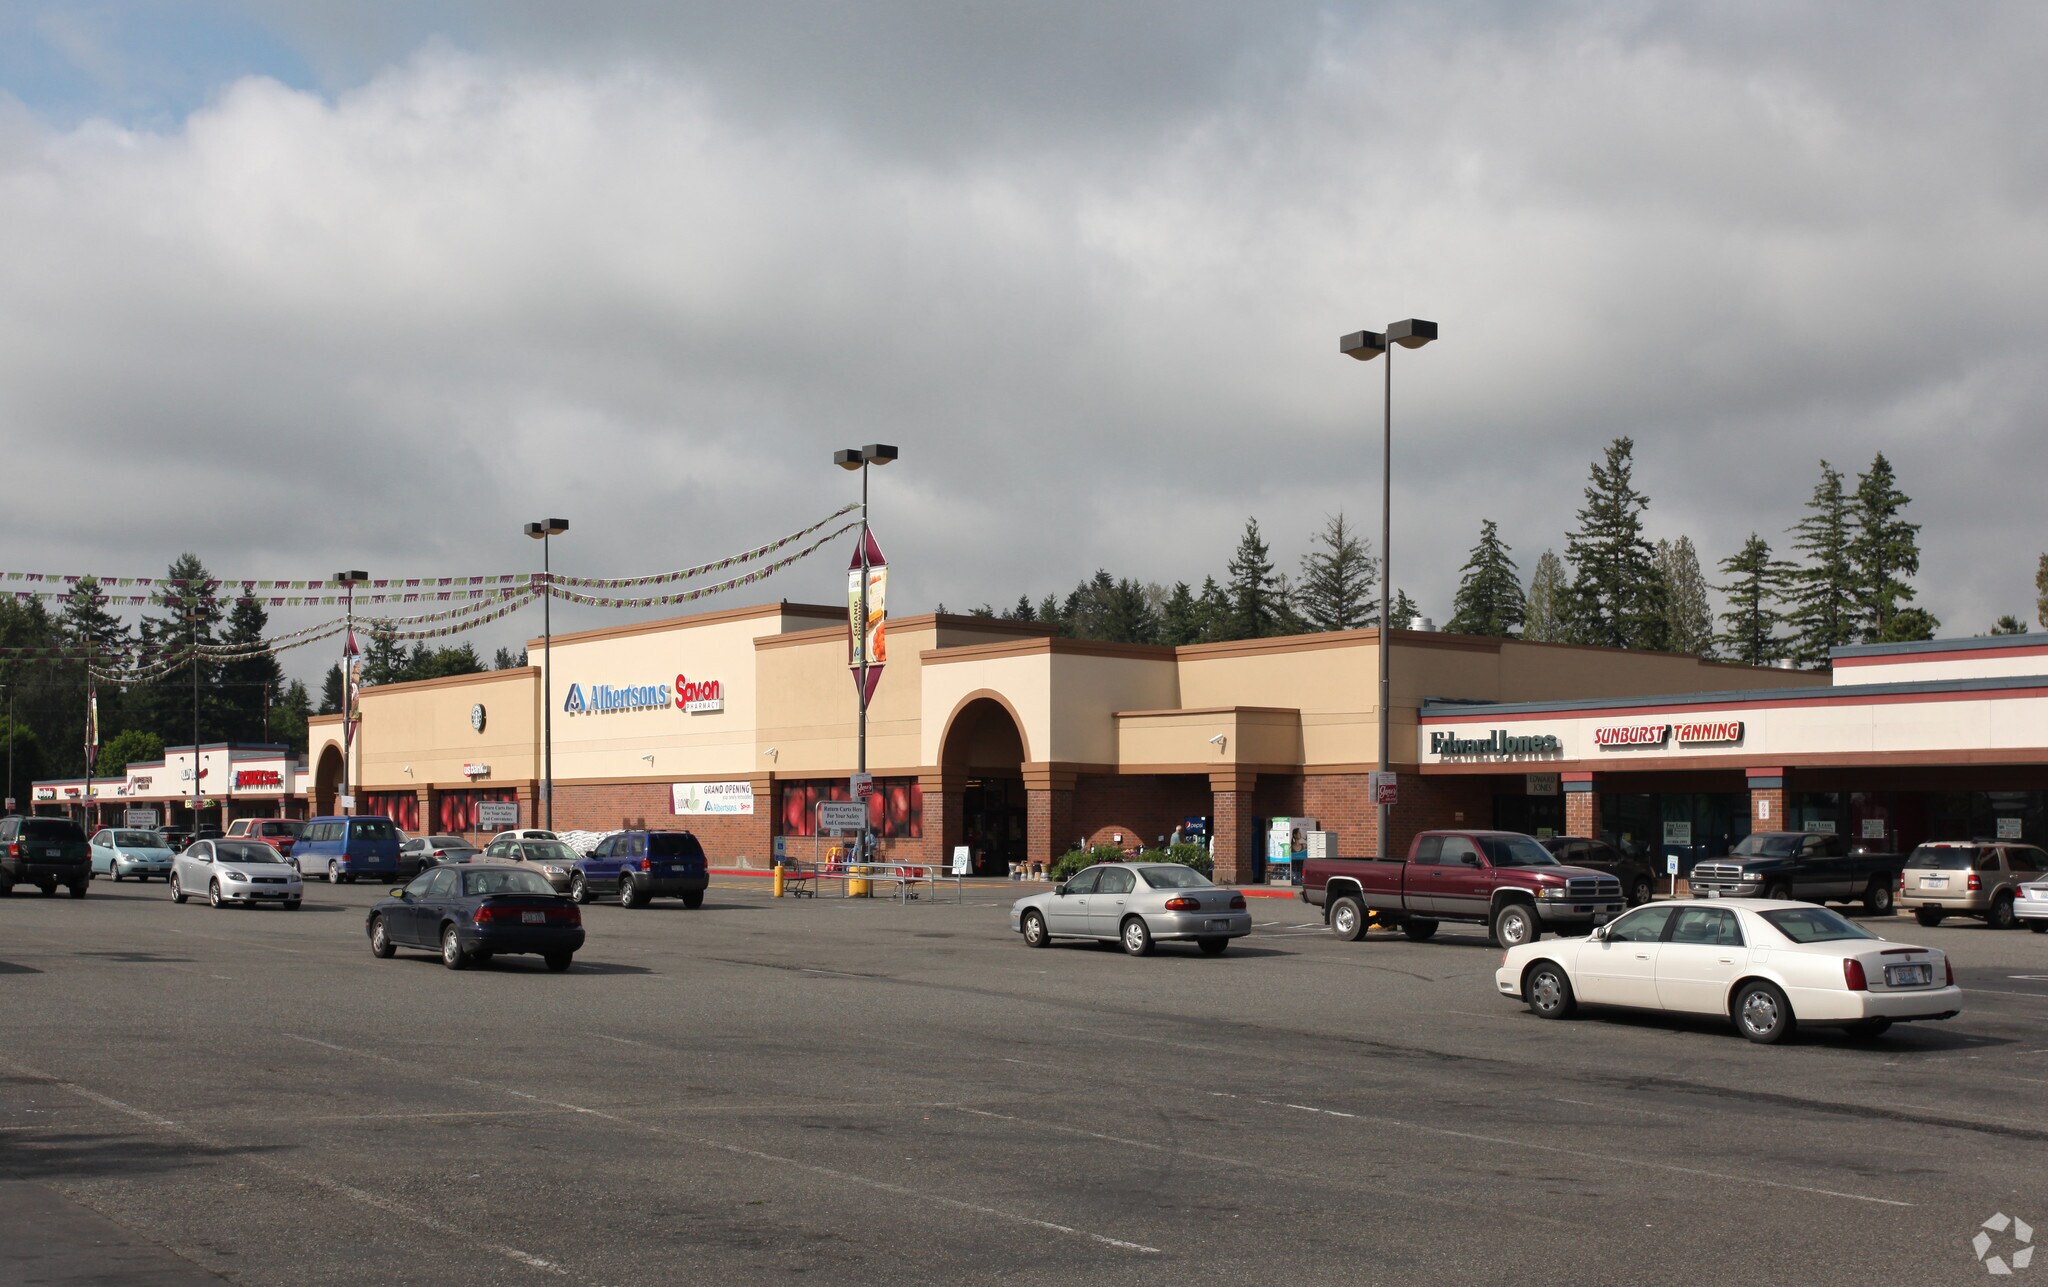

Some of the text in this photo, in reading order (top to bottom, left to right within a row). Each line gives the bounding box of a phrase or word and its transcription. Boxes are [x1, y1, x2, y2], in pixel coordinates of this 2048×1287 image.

[590, 684, 666, 710] Albertsons
[686, 702, 719, 710] PHARMACY
[1594, 723, 1738, 744] SUNBURST TANNING
[1430, 730, 1557, 755] Edward Jones
[703, 784, 750, 795] GRAND OPENING
[1533, 784, 1552, 792] JONES
